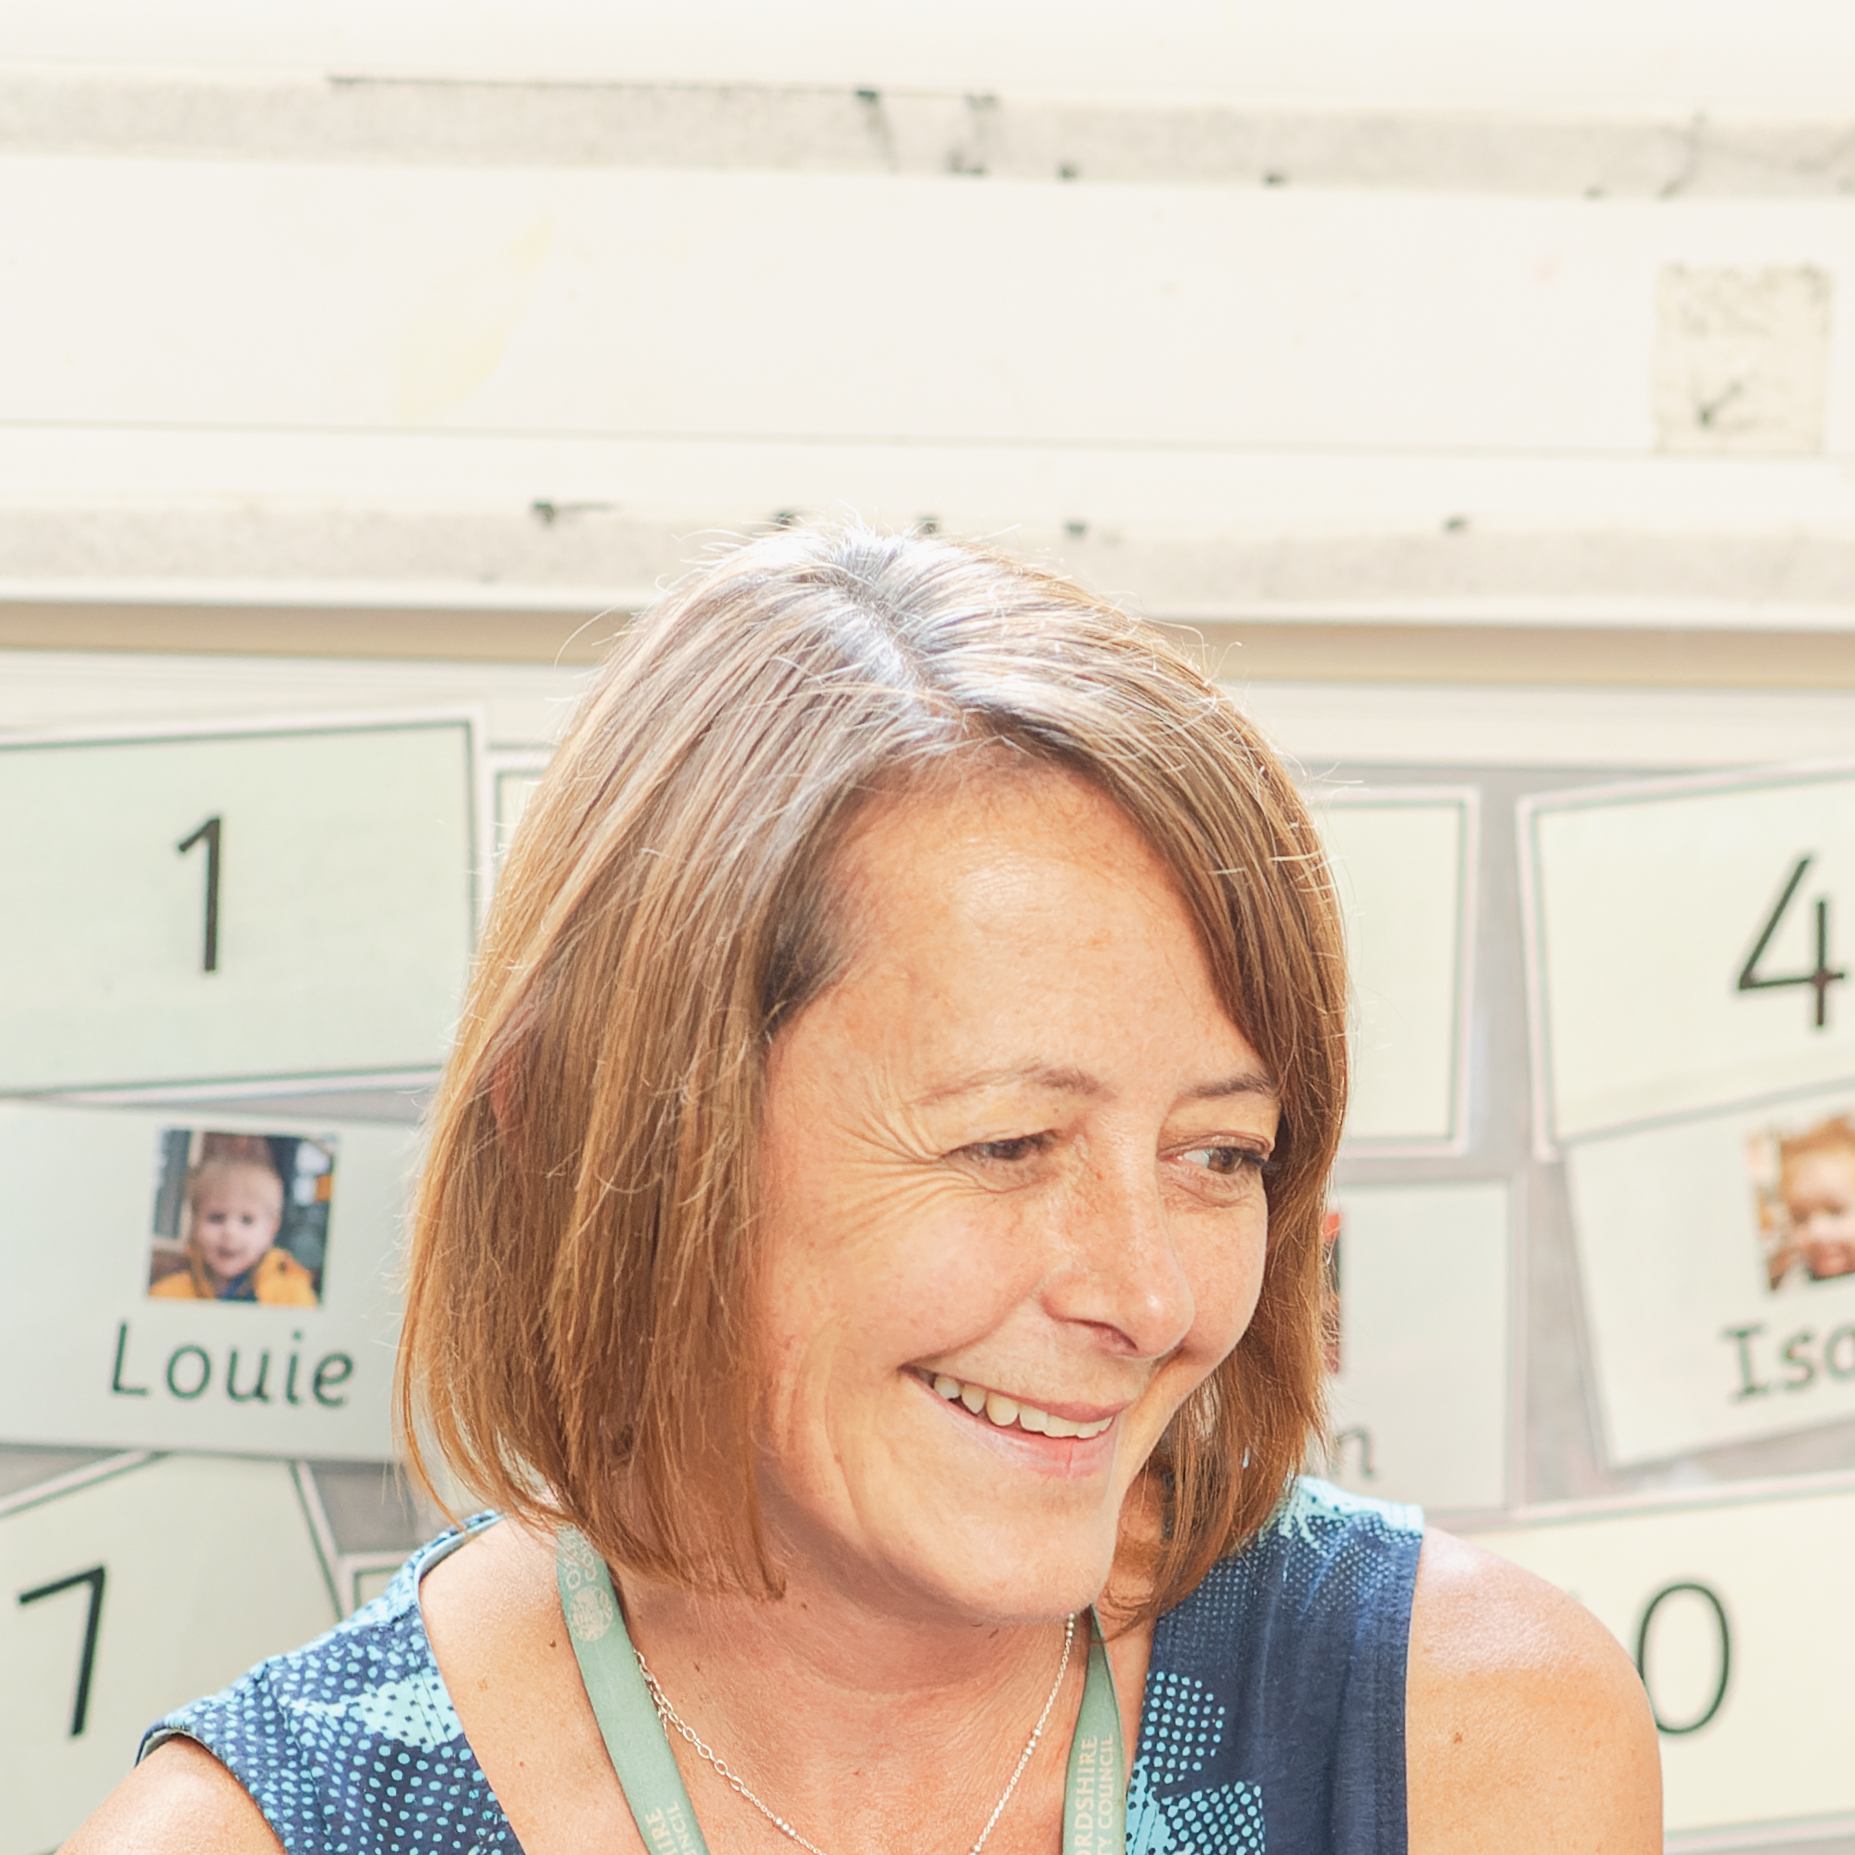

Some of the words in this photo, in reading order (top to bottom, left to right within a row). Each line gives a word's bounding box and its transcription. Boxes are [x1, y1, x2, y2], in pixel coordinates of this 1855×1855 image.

[176, 814, 223, 974] 1
[1734, 851, 1849, 1029] 4
[111, 1321, 355, 1408] Louie
[16, 1562, 107, 1738] 7
[1636, 1580, 1731, 1737] 0
[1097, 1733, 1113, 1830] COUNCIL
